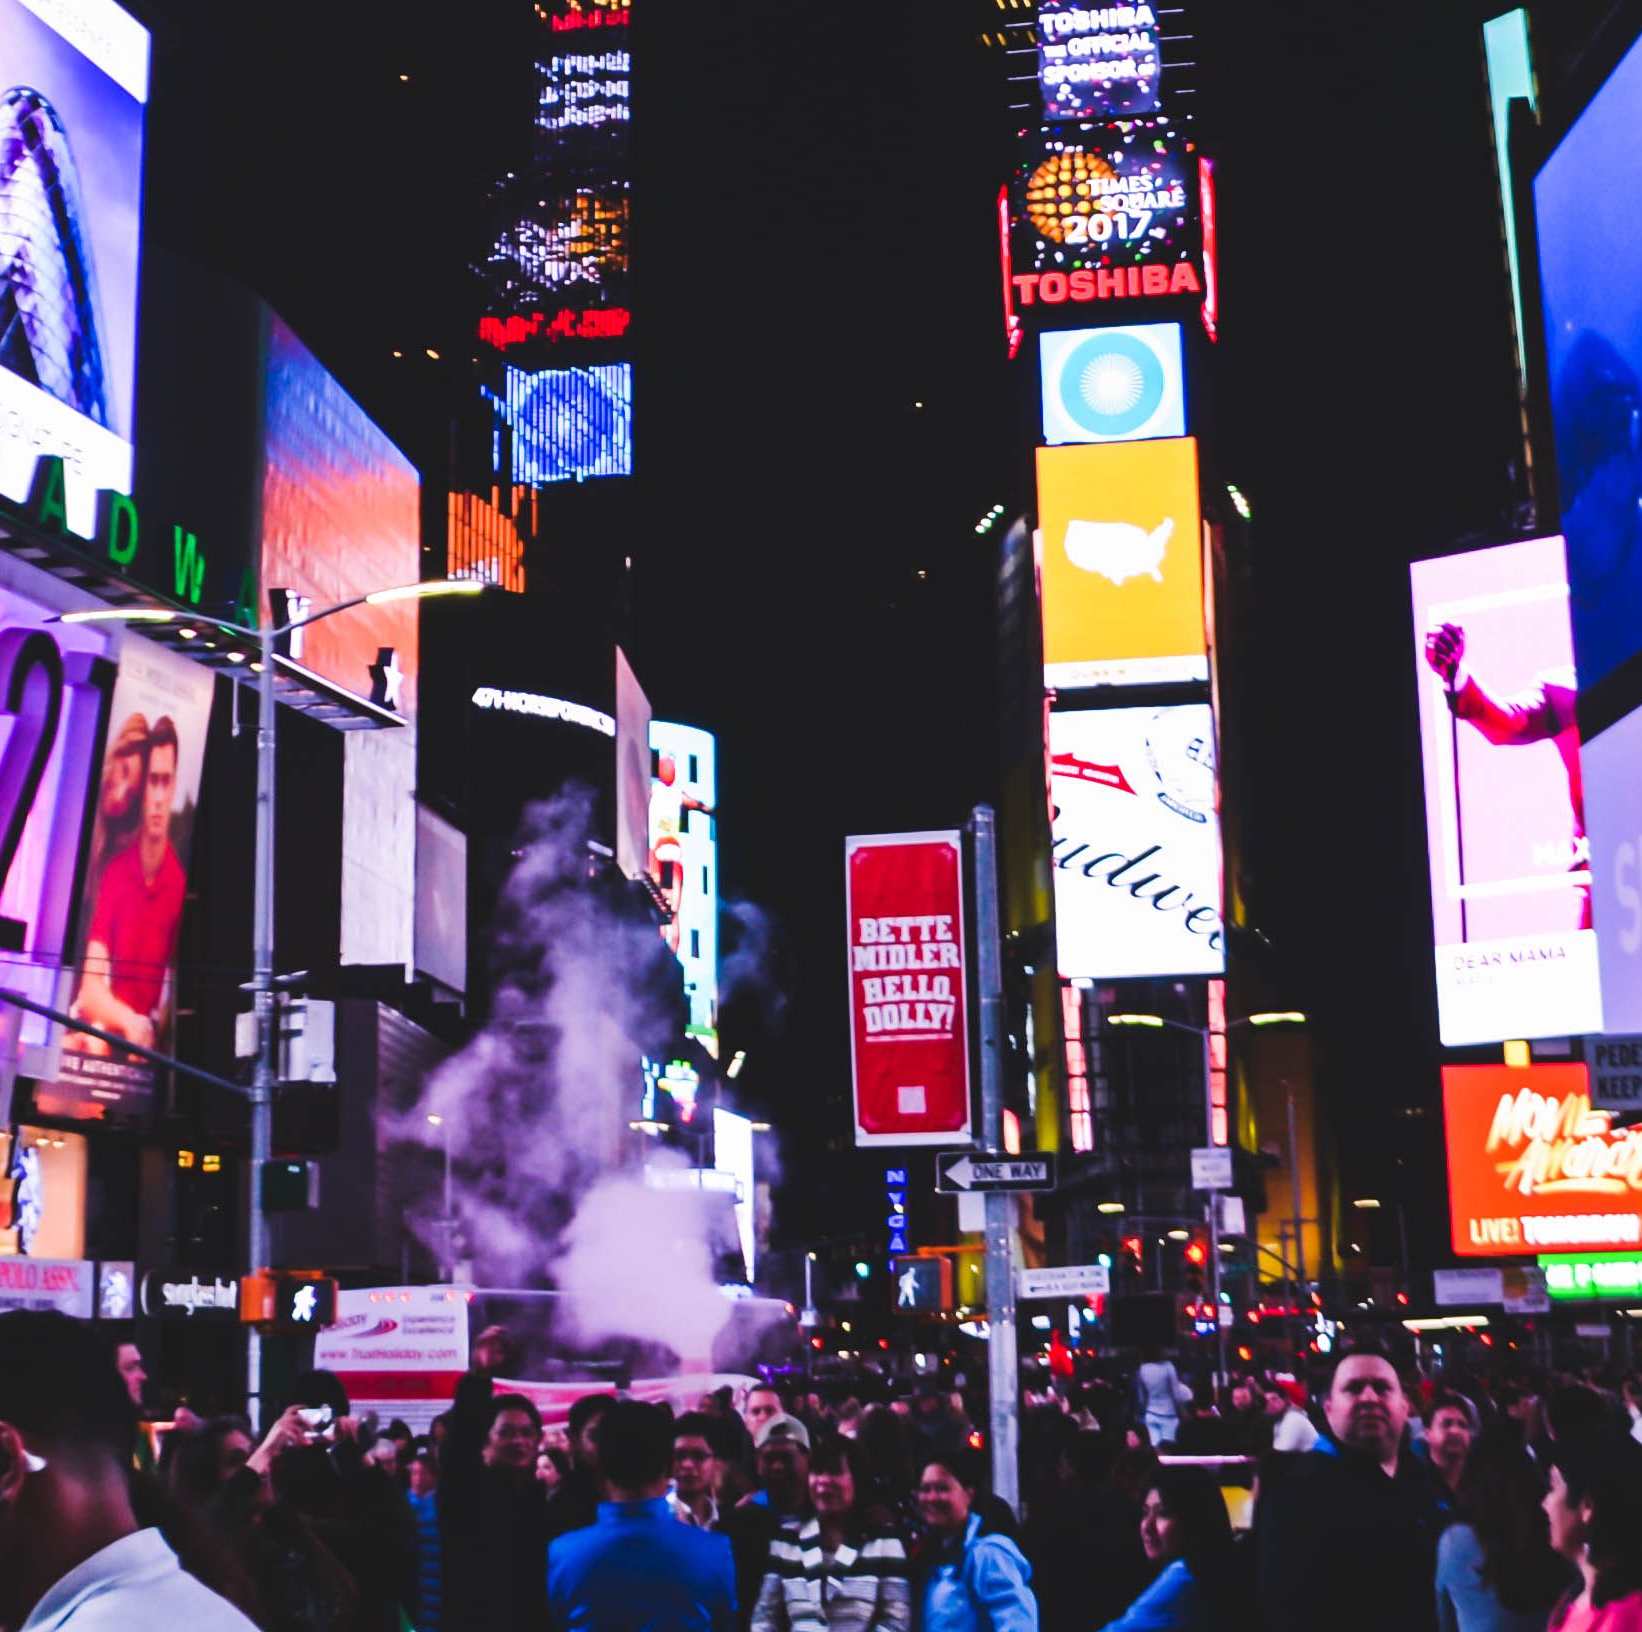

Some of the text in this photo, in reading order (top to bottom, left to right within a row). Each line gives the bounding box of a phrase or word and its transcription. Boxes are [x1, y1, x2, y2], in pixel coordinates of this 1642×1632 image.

[1038, 4, 1157, 35] TOSHIBA
[1042, 59, 1137, 86] SPONSOR
[1086, 174, 1154, 198] TIMES
[1099, 186, 1187, 213] SQUARE
[1062, 210, 1154, 245] 2017
[1012, 261, 1201, 306] TOSHIBA
[1053, 835, 1226, 951] udwe
[859, 914, 953, 943] BETTE
[853, 942, 960, 971] MIDLER
[862, 974, 956, 1005] HELLO,
[863, 1002, 955, 1033] DOLLY!
[972, 1161, 1041, 1179] ONE WAY
[1469, 1217, 1520, 1244] LIVE!
[1520, 1213, 1641, 1245] TOMORROW
